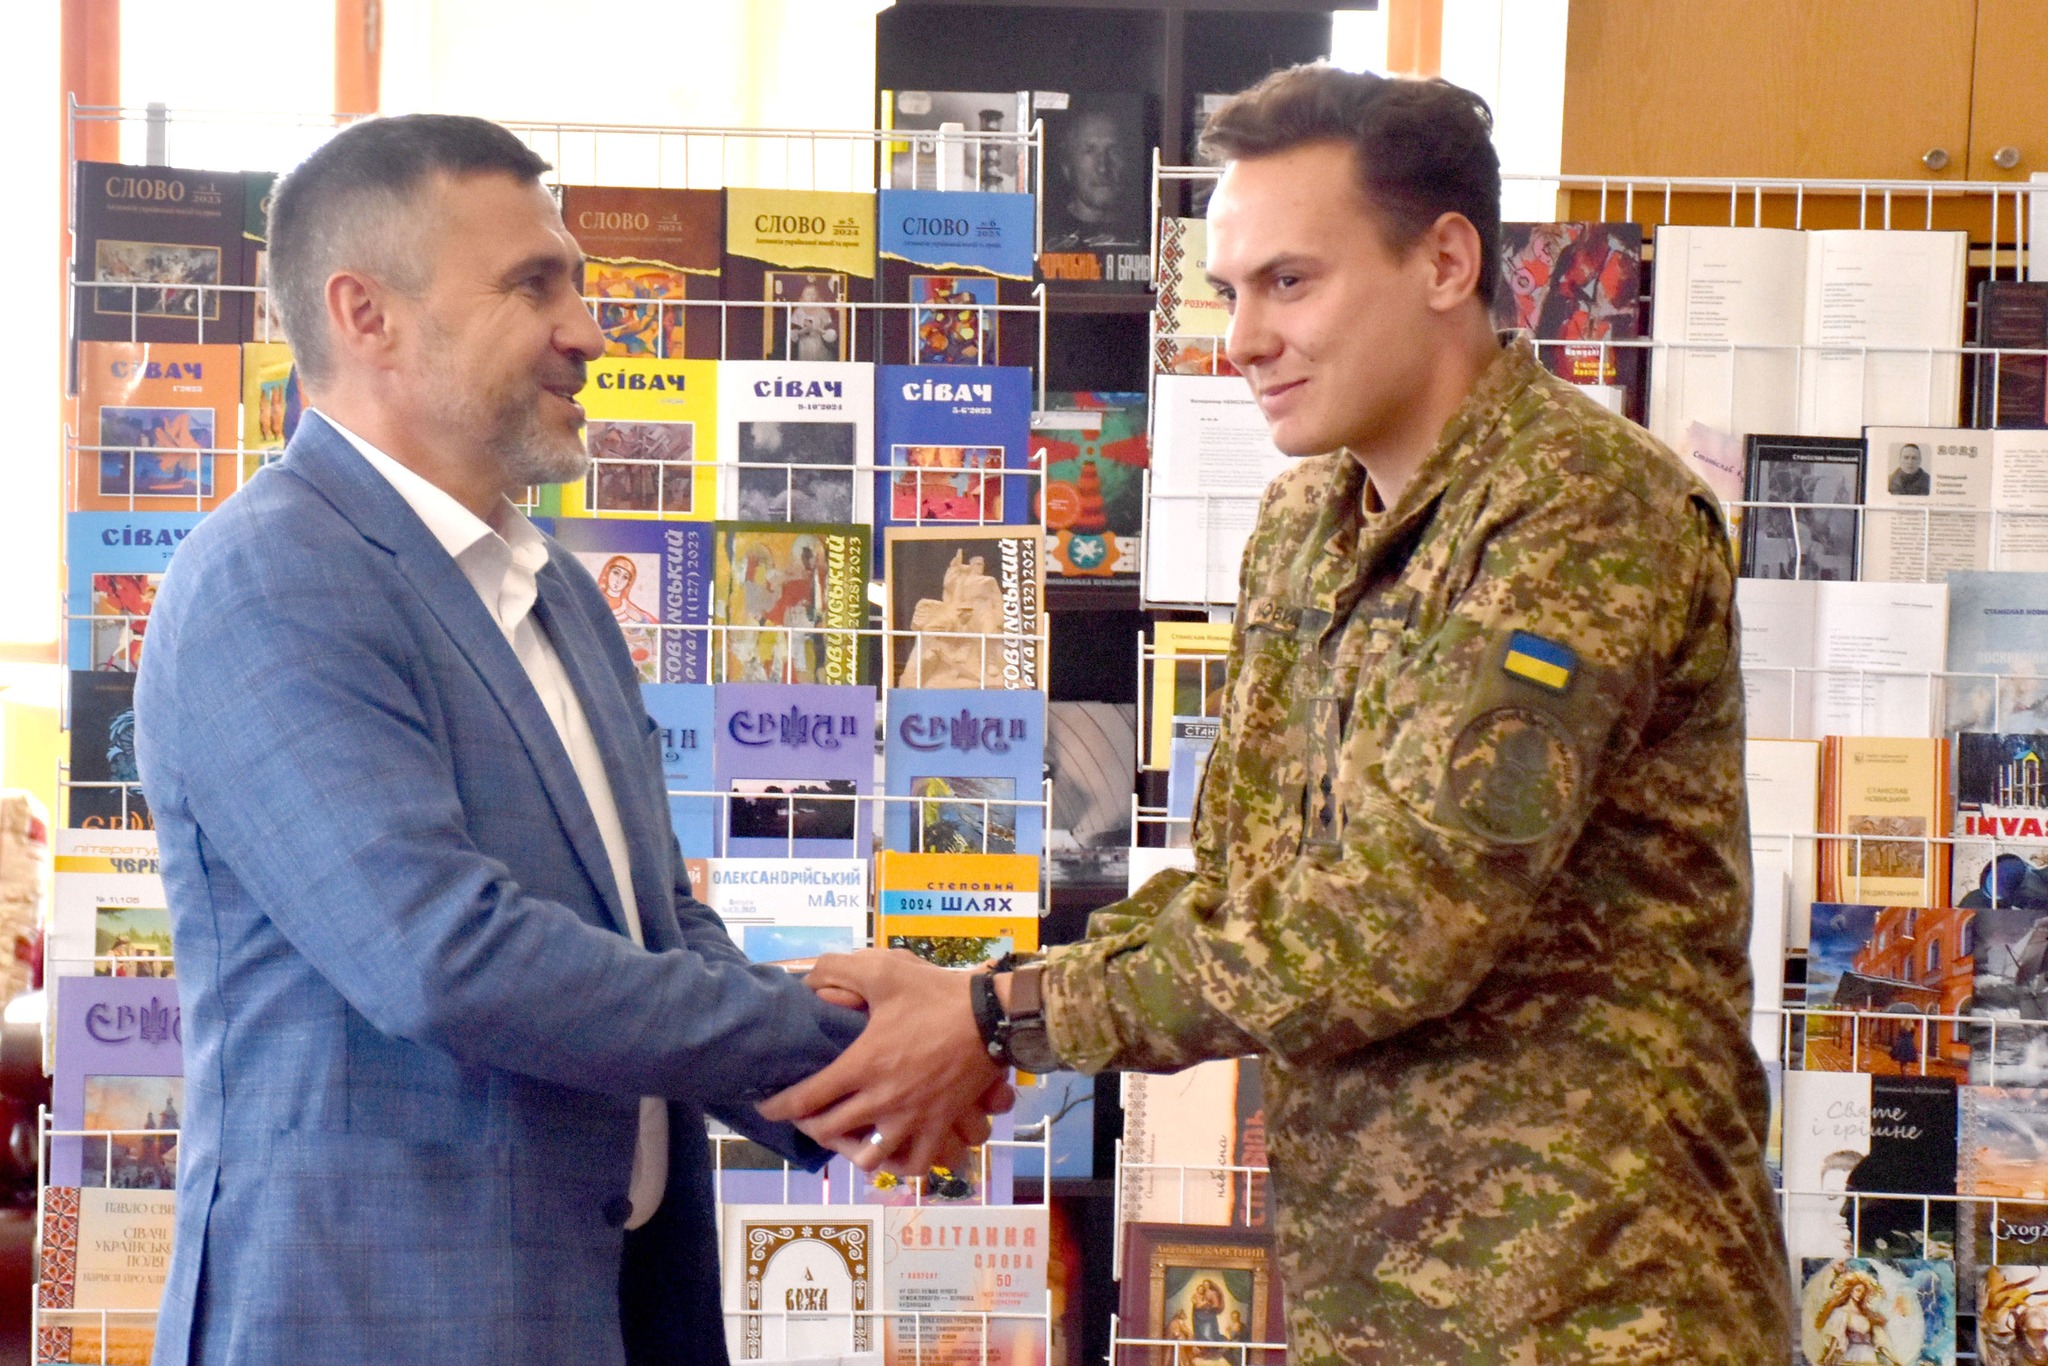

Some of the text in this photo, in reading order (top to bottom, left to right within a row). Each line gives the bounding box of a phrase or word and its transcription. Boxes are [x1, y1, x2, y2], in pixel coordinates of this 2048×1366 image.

[106, 177, 185, 201] СЛОВО
[579, 211, 650, 231] СЛОВО
[755, 214, 826, 234] СЛОВО
[903, 217, 969, 236] СЛОВО
[597, 369, 685, 391] СІВАЧ
[753, 376, 843, 398] СІВАЧ
[902, 379, 993, 402] СІВАЧ
[712, 866, 861, 886] ОЛЕКСАНДРІЙСЬКИЙ
[900, 896, 1012, 912] 2024 ШЛЯХ
[1833, 1123, 1923, 1142] грішне
[901, 1225, 1036, 1248] СВІТАННЯ
[974, 1253, 1033, 1269] СЛОВА
[996, 1273, 1012, 1287] 50
